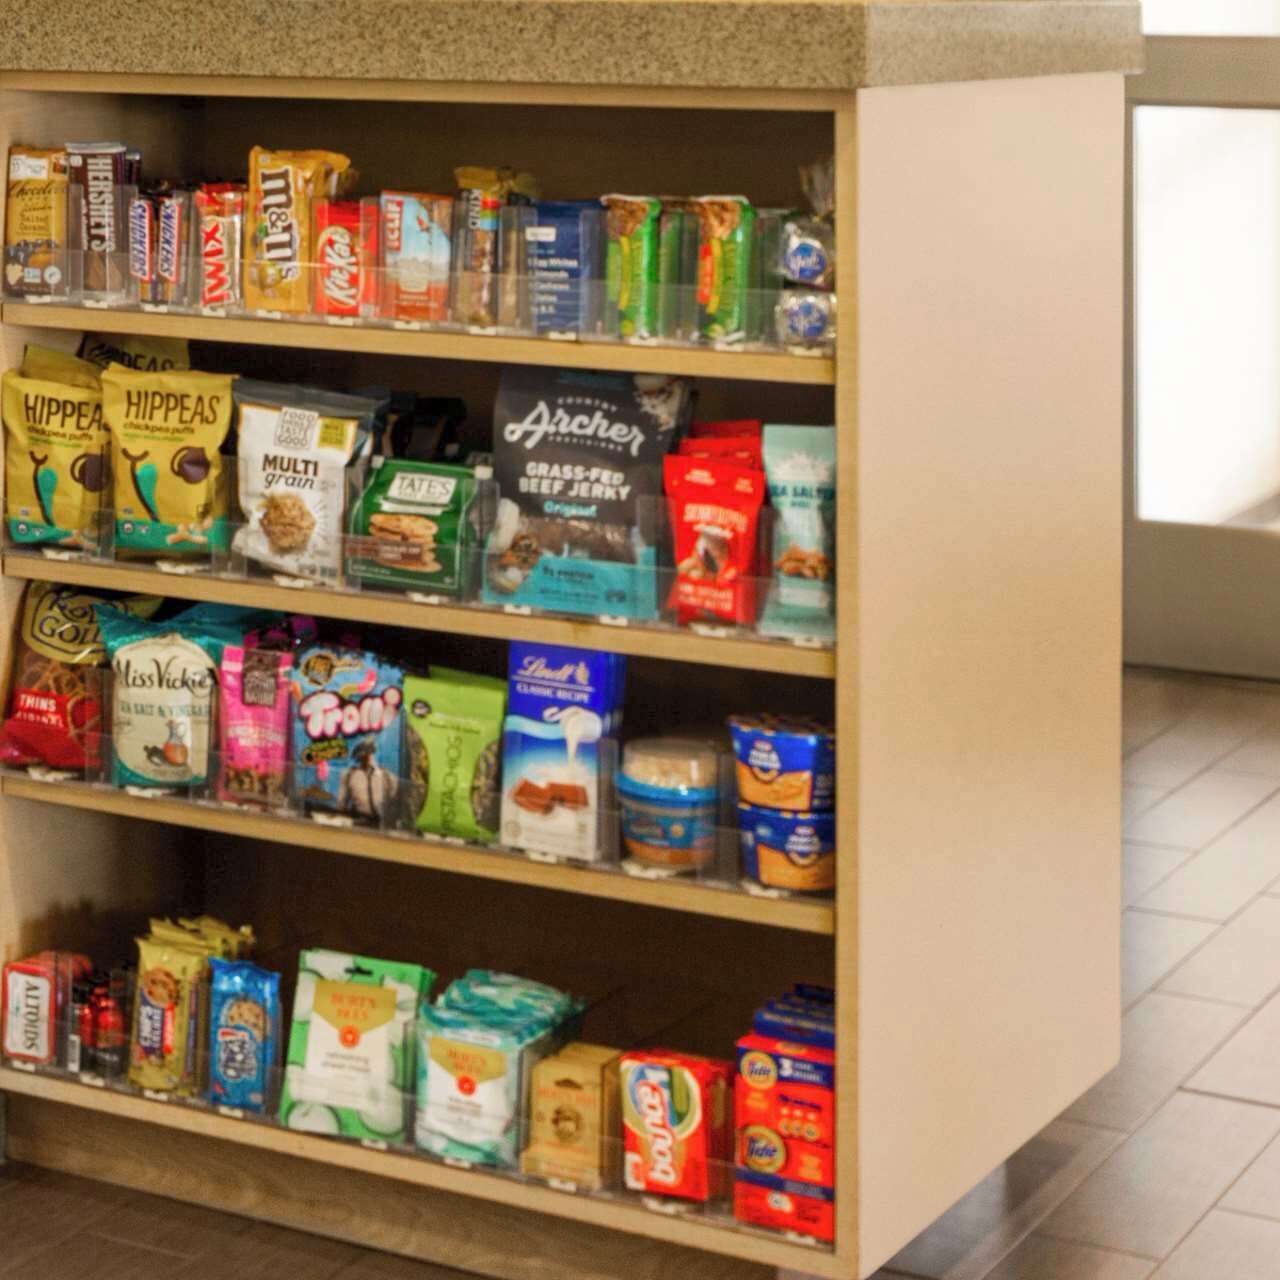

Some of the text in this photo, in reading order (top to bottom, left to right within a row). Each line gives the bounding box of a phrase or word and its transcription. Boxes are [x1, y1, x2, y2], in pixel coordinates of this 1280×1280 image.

[86, 155, 116, 252] HERSHEY'S
[130, 200, 149, 277] SNICKERS
[159, 199, 180, 276] SNICKERS
[201, 222, 231, 307] TWIX
[124, 389, 222, 426] HIPPEAS
[503, 400, 646, 457] Archer
[262, 453, 319, 477] MULTI
[264, 471, 316, 490] grain
[525, 461, 625, 485] GRASS-FED
[518, 477, 632, 501] BEEF JERKY
[38, 615, 101, 645] GOL
[19, 693, 57, 712] THINS
[299, 687, 402, 740] Trolli
[24, 980, 41, 1051] ALTOIDS
